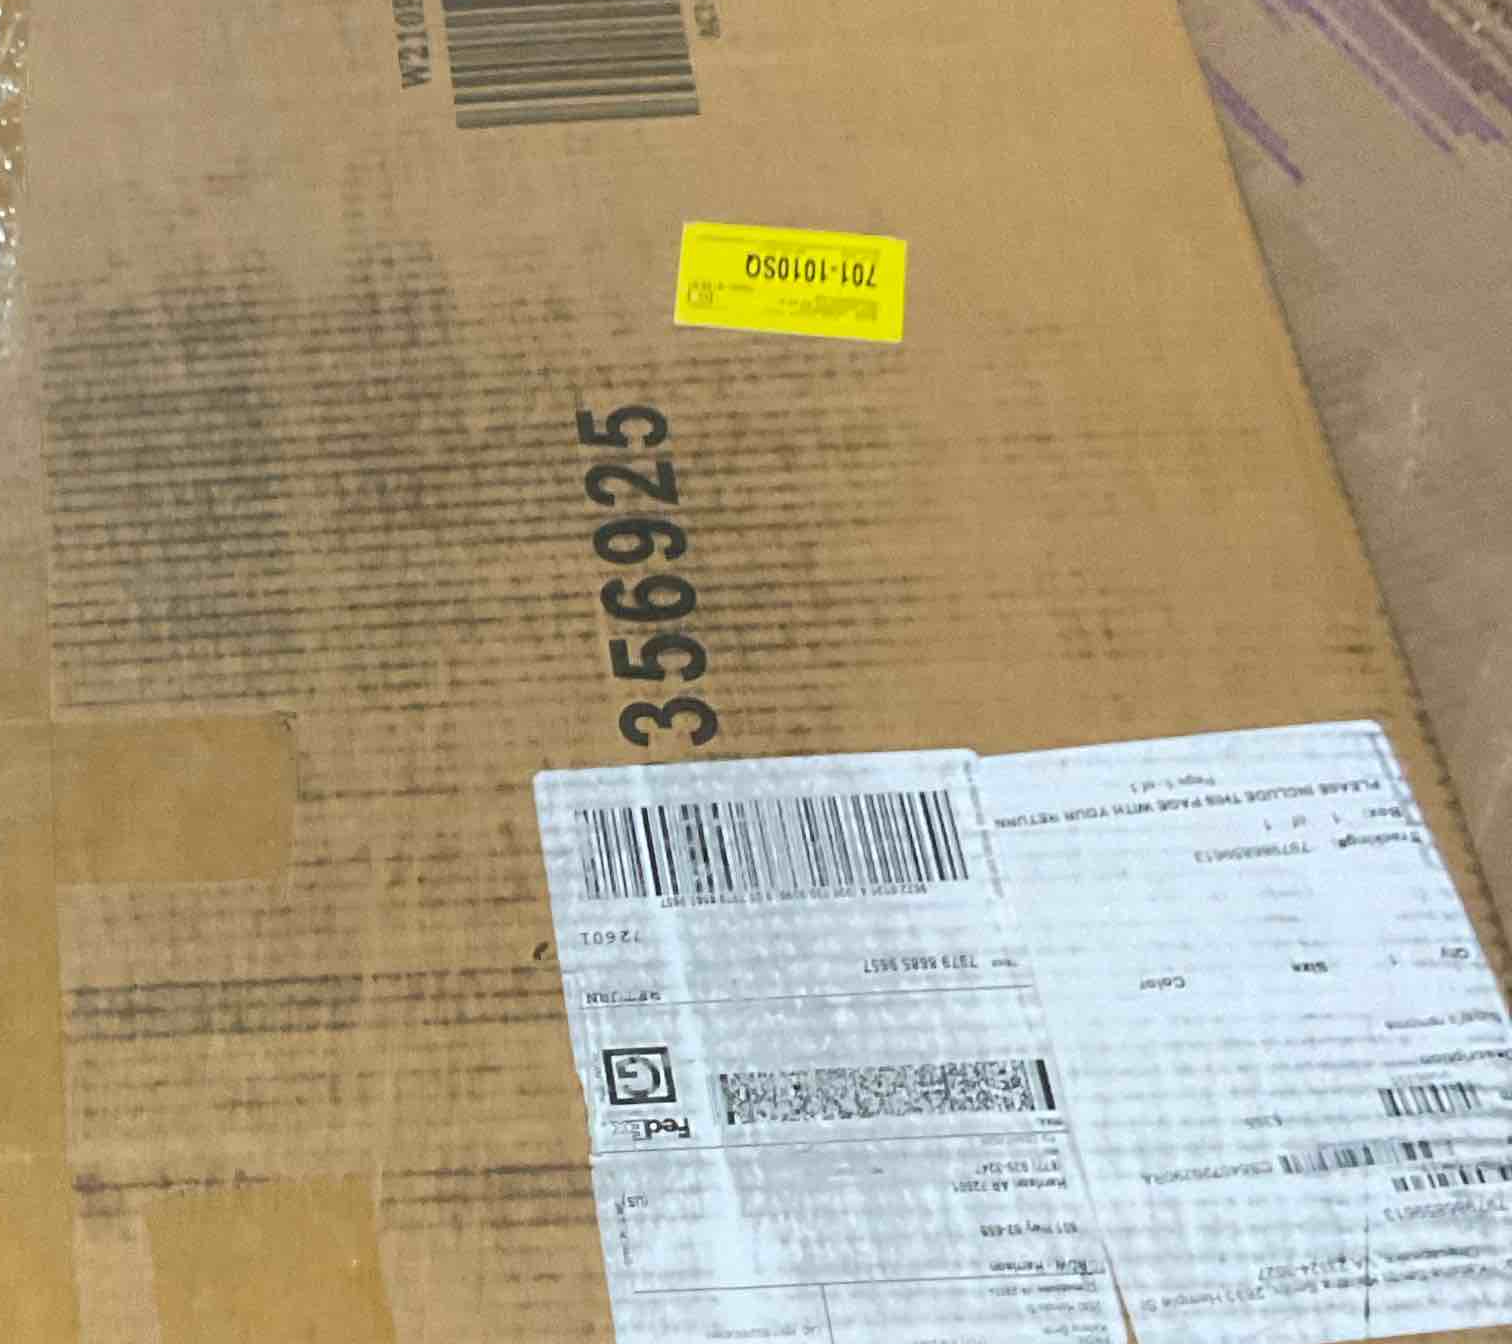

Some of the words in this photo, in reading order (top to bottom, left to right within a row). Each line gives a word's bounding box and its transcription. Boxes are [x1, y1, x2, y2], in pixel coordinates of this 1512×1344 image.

[745, 253, 878, 289] 701-1010SQ
[575, 404, 719, 747] 356925
[994, 812, 1061, 830] RETURN
[1139, 976, 1187, 992] Color
